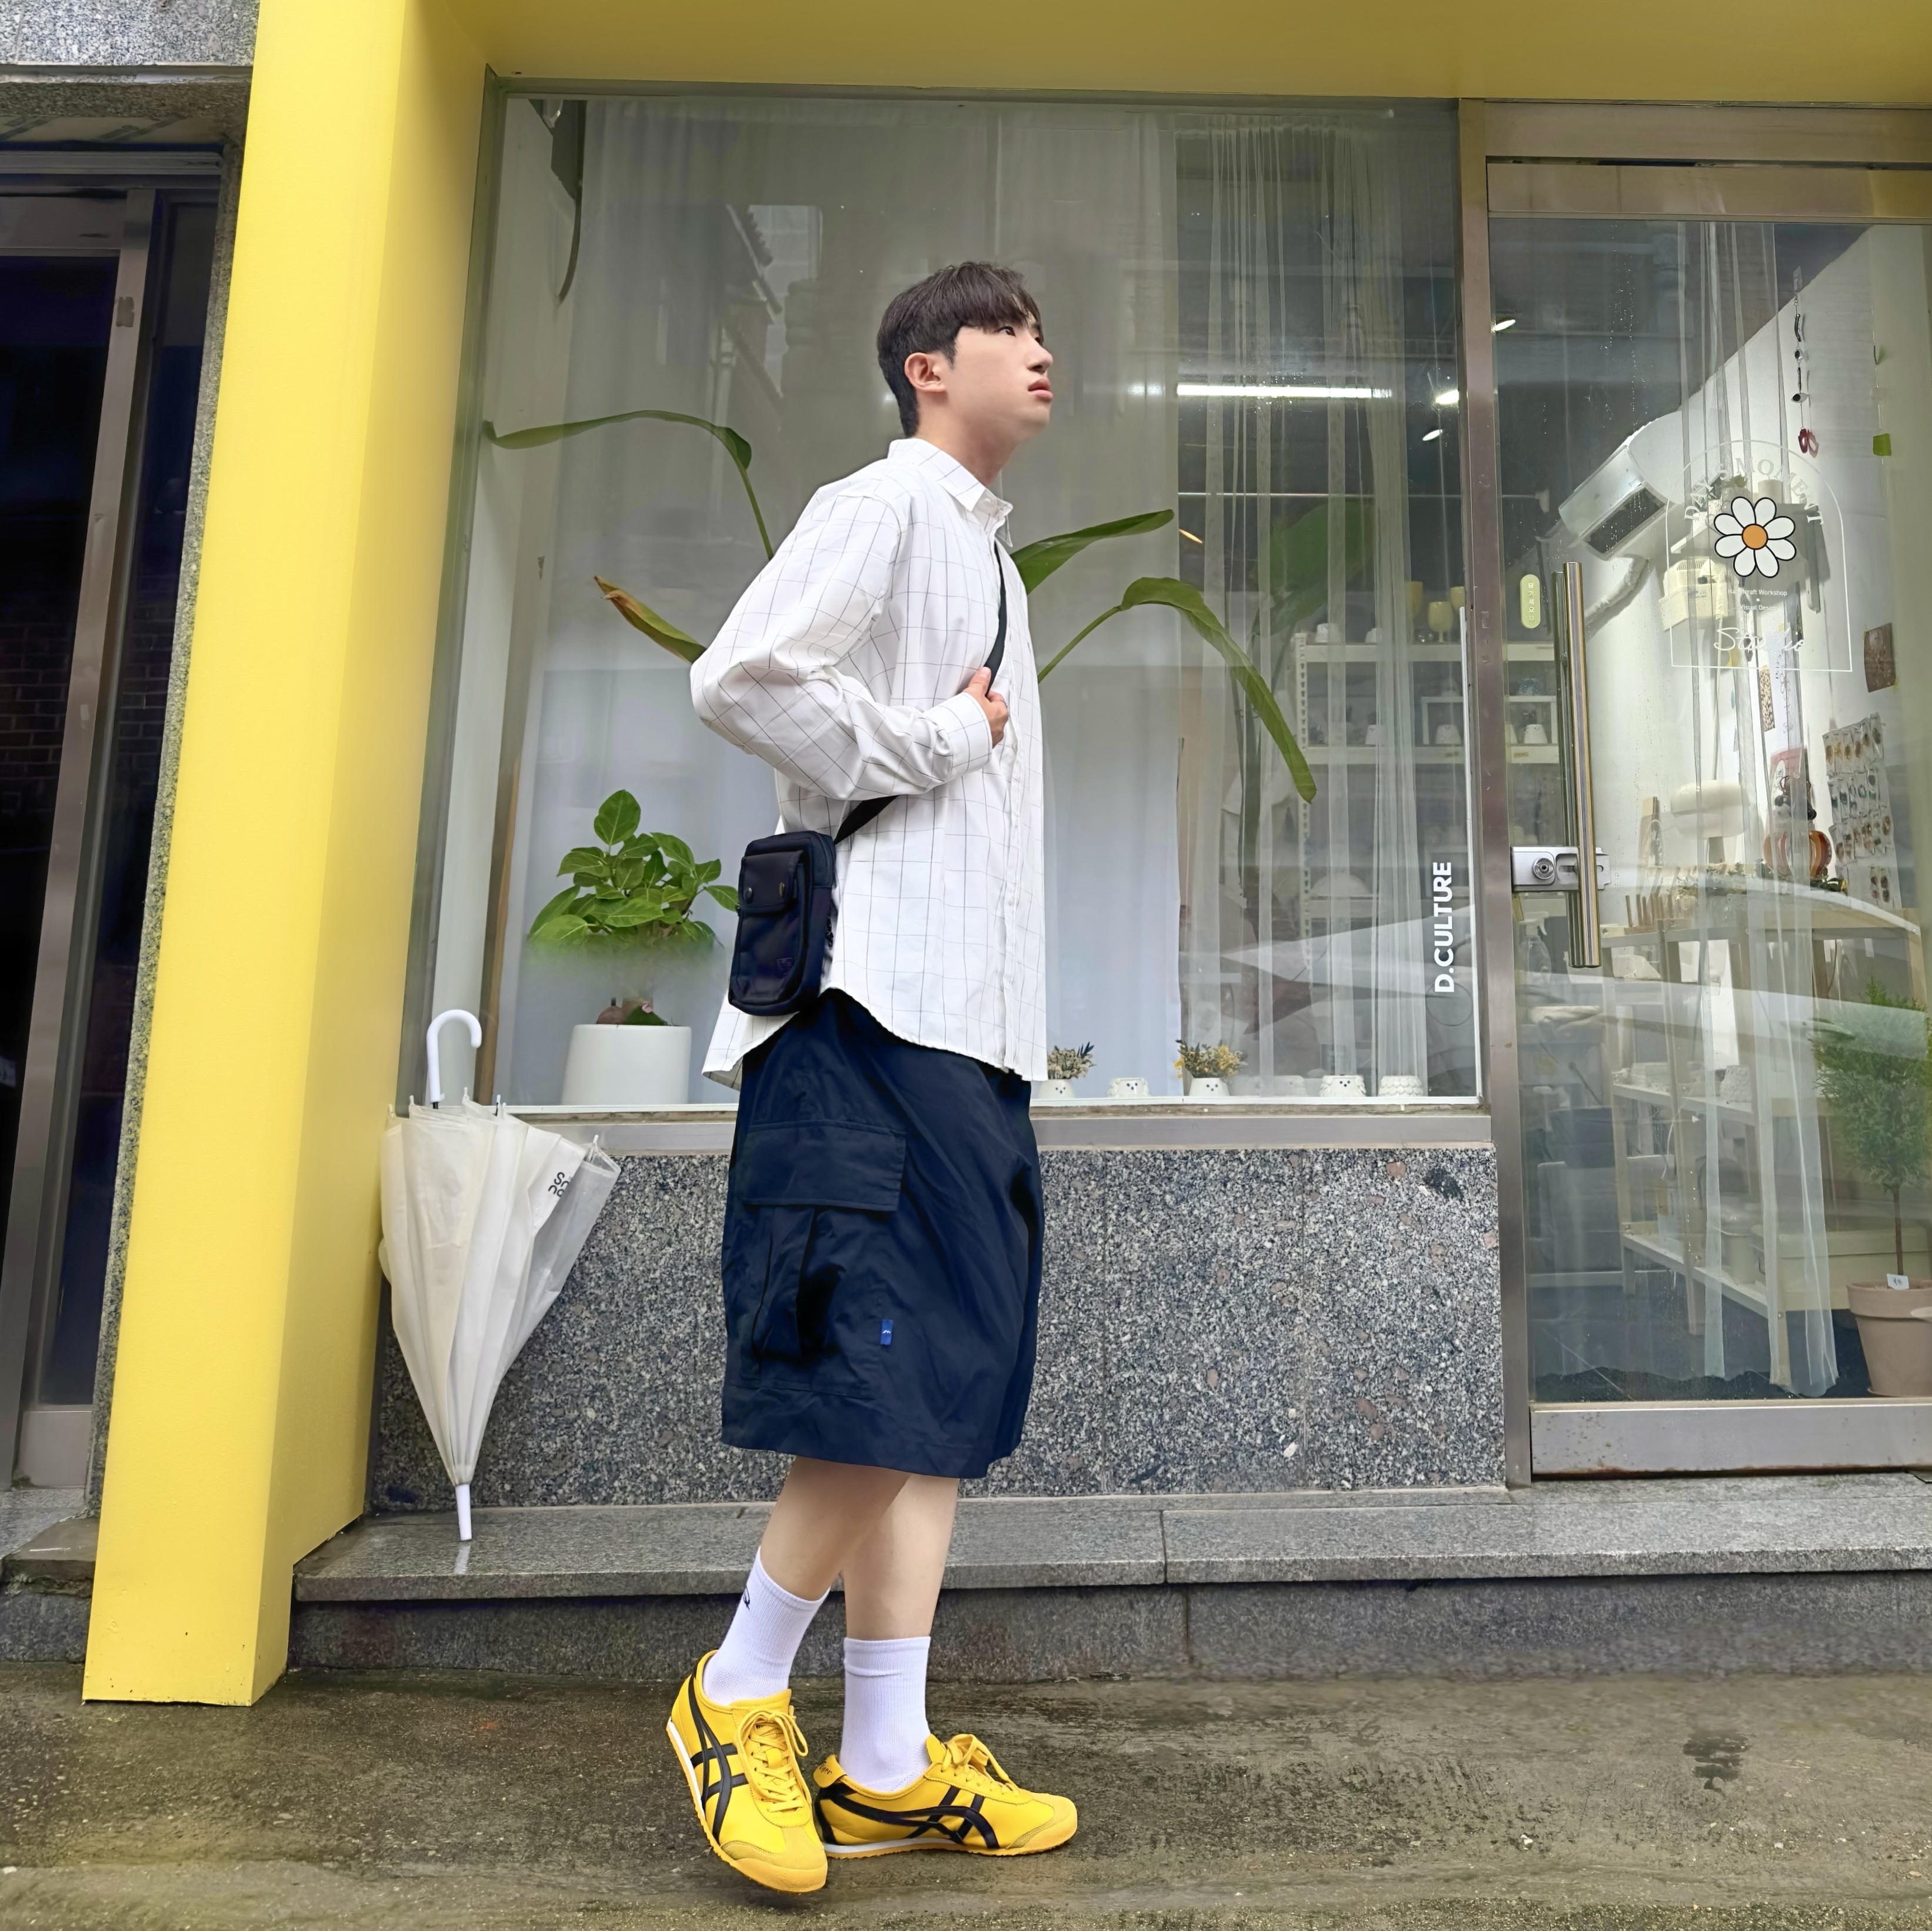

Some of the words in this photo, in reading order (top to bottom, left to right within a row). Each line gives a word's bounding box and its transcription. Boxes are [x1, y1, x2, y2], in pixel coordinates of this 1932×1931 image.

[1684, 462, 1730, 522] DAYS
[1758, 589, 1788, 597] Workshop
[1433, 862, 1454, 992] D.CULTURE
